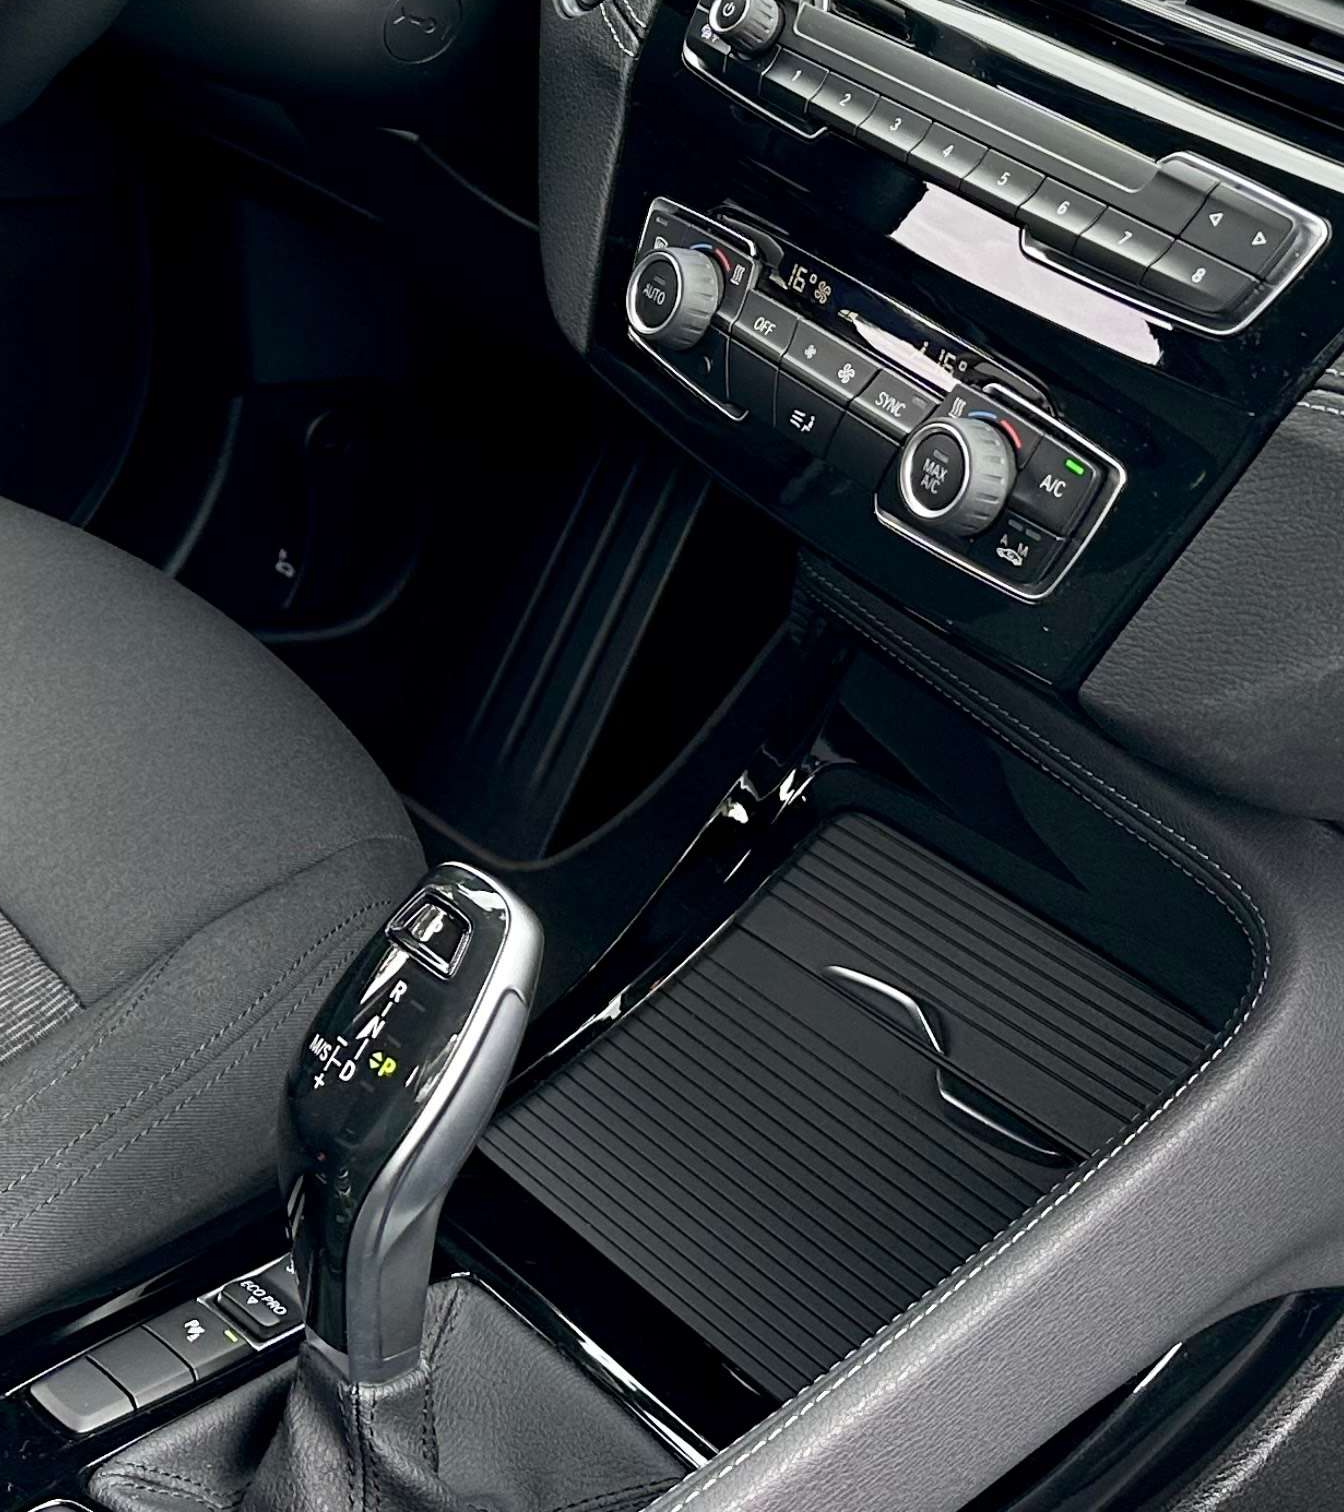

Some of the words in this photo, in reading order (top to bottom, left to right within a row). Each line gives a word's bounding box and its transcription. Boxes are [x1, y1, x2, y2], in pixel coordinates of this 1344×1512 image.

[792, 69, 802, 82] 1
[839, 93, 852, 107] 2
[889, 117, 902, 132] 3
[942, 144, 954, 158] 4
[996, 172, 1010, 186] 5
[1056, 200, 1070, 216] 6
[1118, 230, 1132, 245] 7
[1191, 267, 1206, 283] 8
[642, 281, 666, 306] AUTO
[754, 316, 776, 336] OFF
[874, 390, 907, 418] SYNC
[923, 458, 948, 483] MAX
[920, 475, 939, 495] A/C
[1039, 473, 1067, 498] A/C
[389, 979, 408, 1003] R
[309, 1034, 332, 1062] M/S
[338, 1059, 356, 1082] D
[377, 1056, 397, 1077] P
[240, 1280, 267, 1297] ECO
[261, 1295, 288, 1316] PRO
